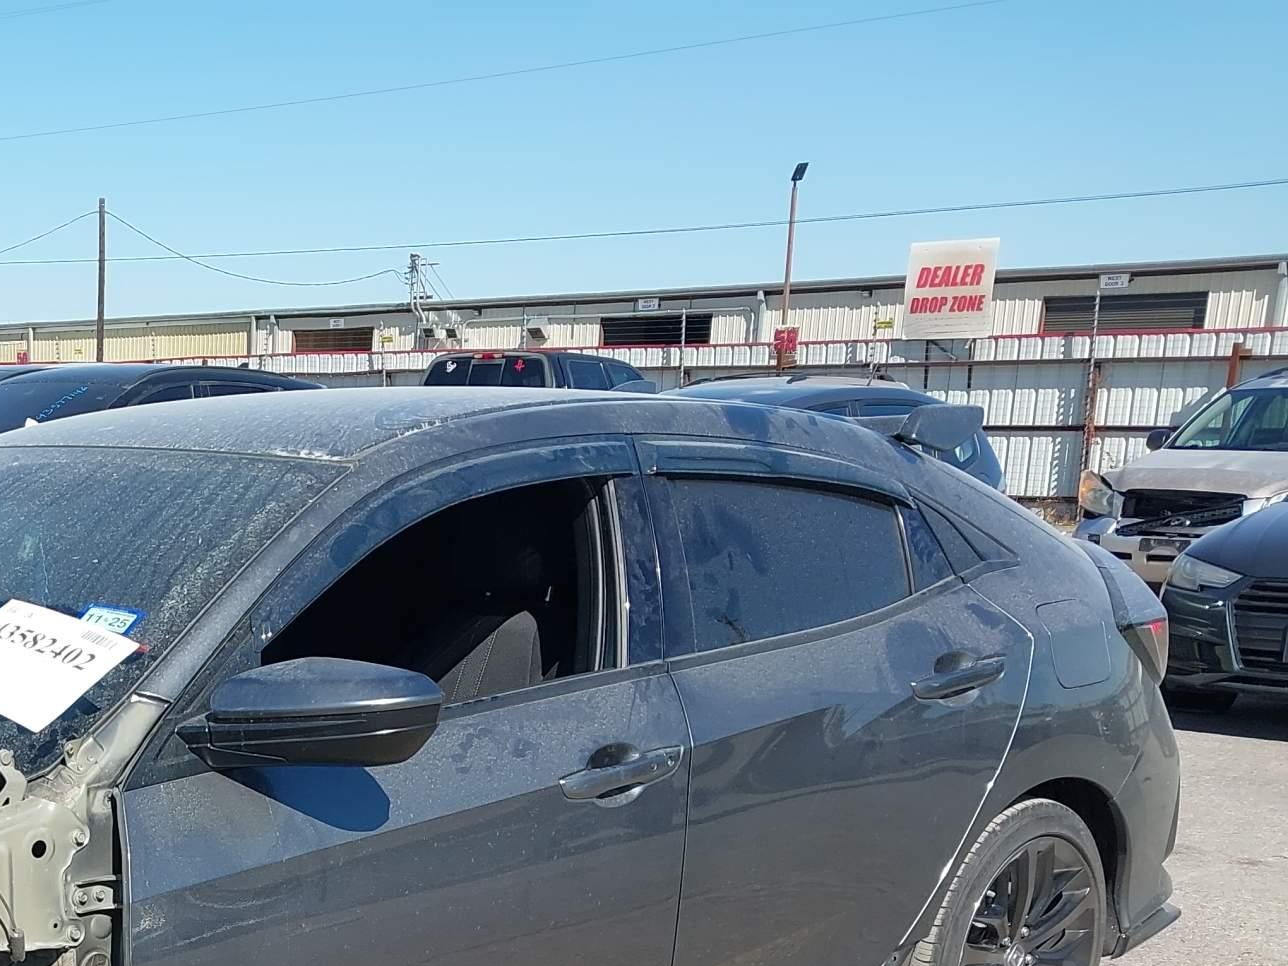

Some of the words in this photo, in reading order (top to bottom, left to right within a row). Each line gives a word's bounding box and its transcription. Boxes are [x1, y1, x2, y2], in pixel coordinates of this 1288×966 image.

[916, 264, 985, 289] DEALER
[909, 296, 948, 315] DROP
[949, 295, 986, 313] ZONE
[85, 612, 103, 624] 11
[108, 617, 130, 629] 25
